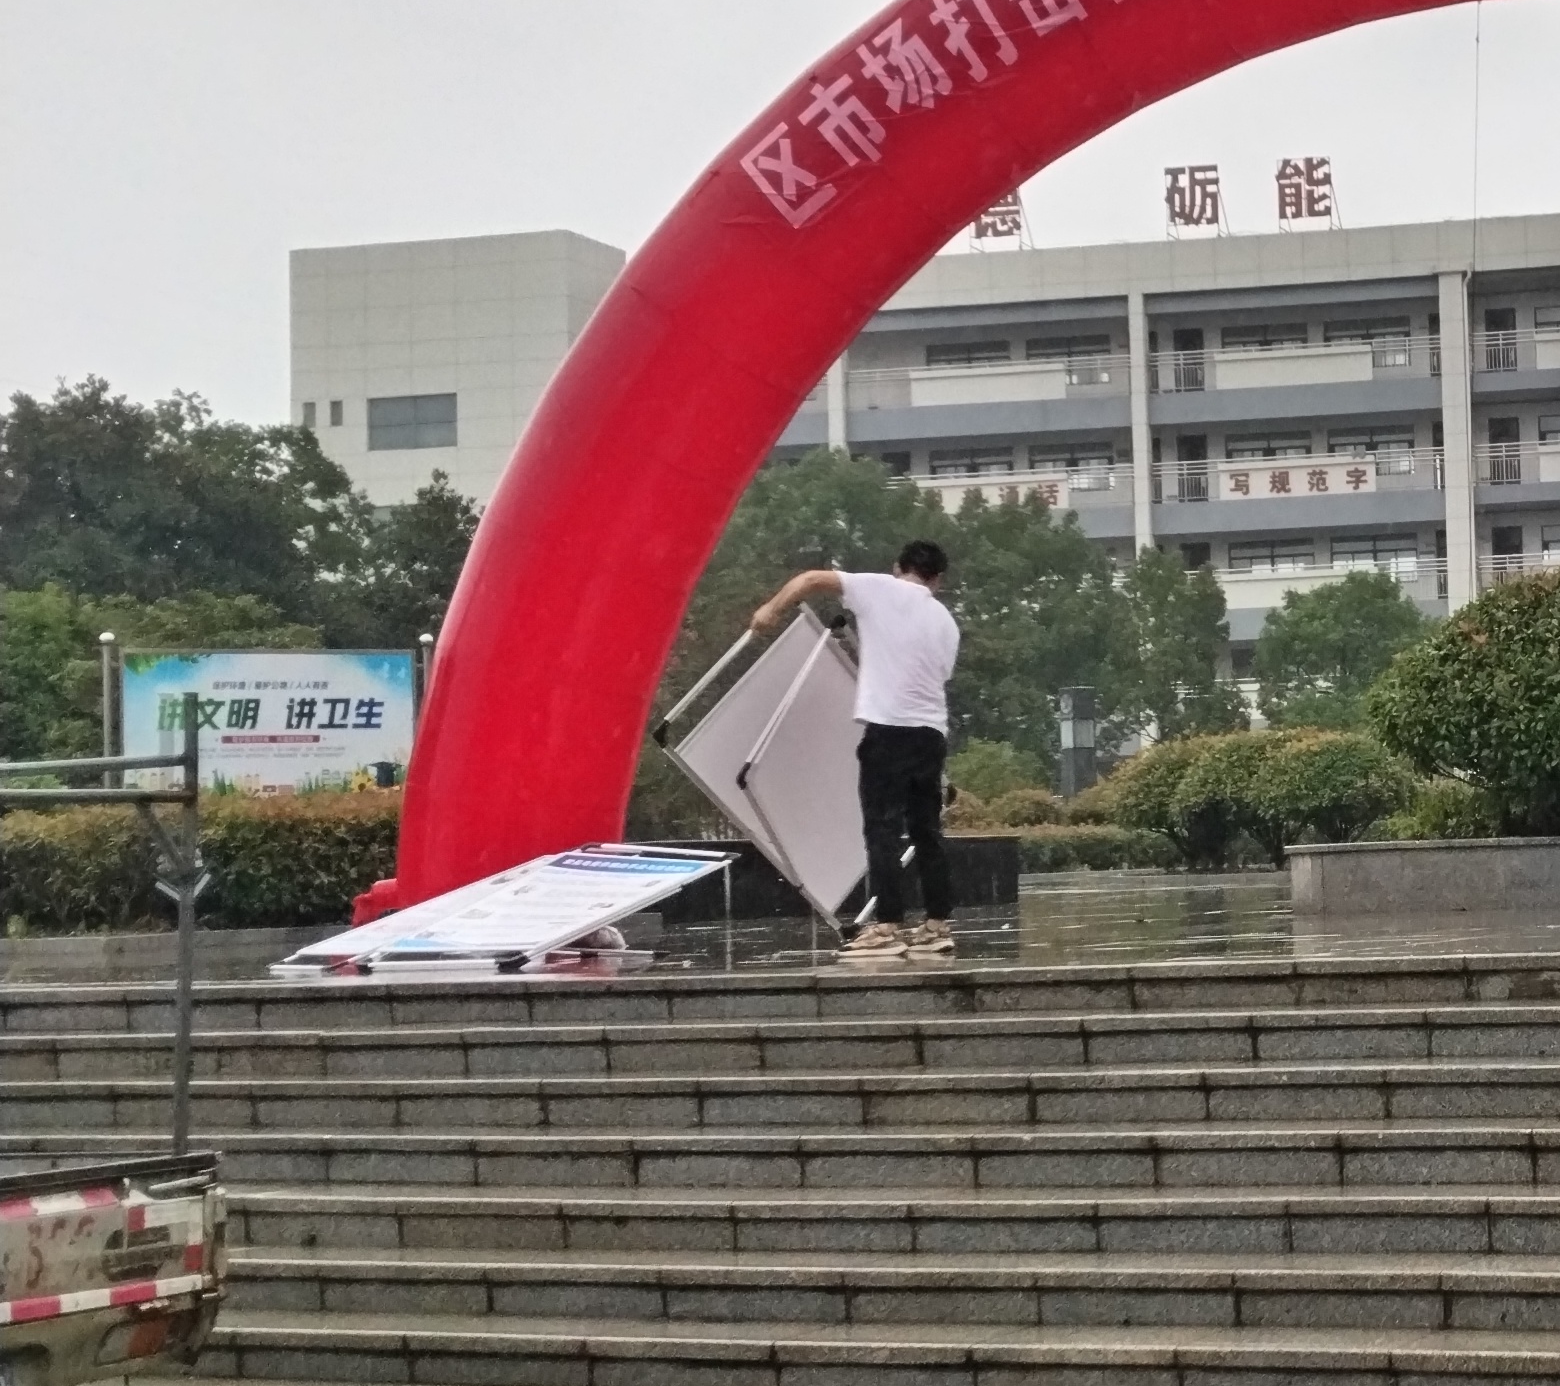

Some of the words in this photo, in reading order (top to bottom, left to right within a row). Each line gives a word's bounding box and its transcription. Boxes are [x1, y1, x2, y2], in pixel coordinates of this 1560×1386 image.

[1165, 157, 1331, 226] 砺能
[1229, 467, 1368, 495] 写规范字
[286, 697, 385, 730] 讲卫生
